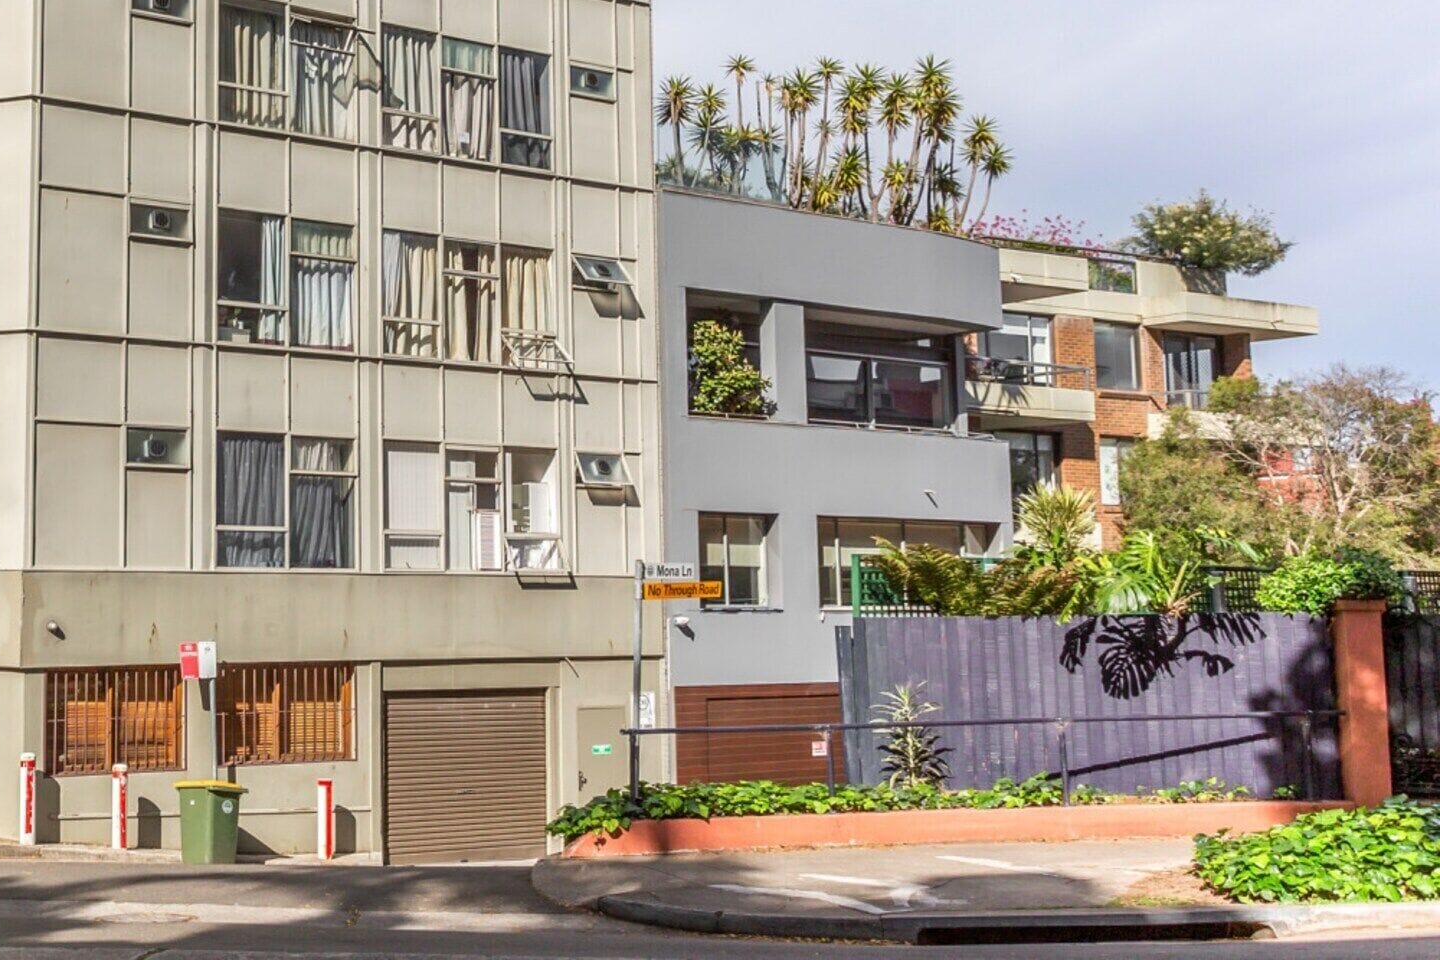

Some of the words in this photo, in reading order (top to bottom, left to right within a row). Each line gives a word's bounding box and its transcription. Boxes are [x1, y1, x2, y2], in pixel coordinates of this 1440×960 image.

[656, 565, 679, 577] Mona
[682, 565, 692, 576] Ln
[647, 585, 662, 596] No
[665, 584, 698, 597] Through
[700, 583, 719, 595] Road
